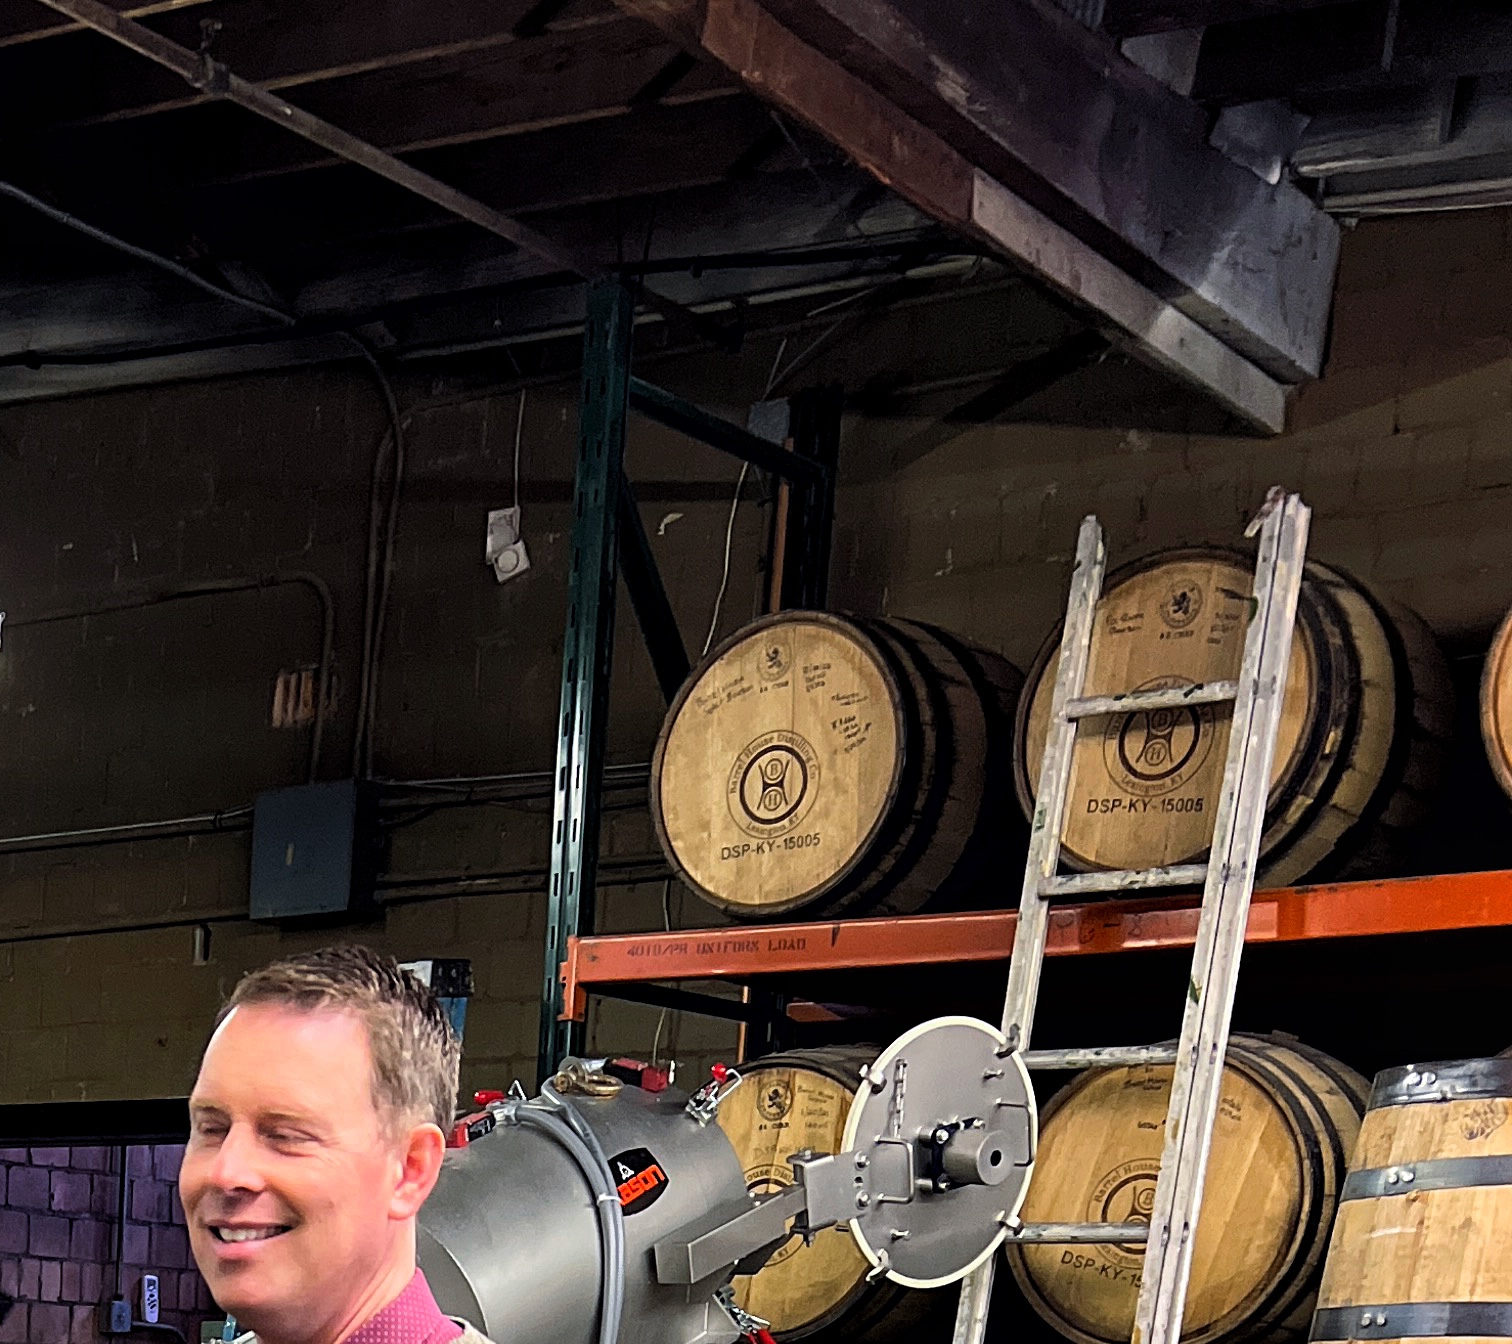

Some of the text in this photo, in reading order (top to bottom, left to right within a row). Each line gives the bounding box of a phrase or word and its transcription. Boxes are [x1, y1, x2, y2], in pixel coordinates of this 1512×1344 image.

[1086, 798, 1205, 814] DSP-KY-15005
[721, 832, 821, 861] DSP-KY-15005
[768, 937, 807, 951] LOAD
[746, 1168, 772, 1181] ouse
[1060, 1250, 1144, 1289] DSP-KY-15
